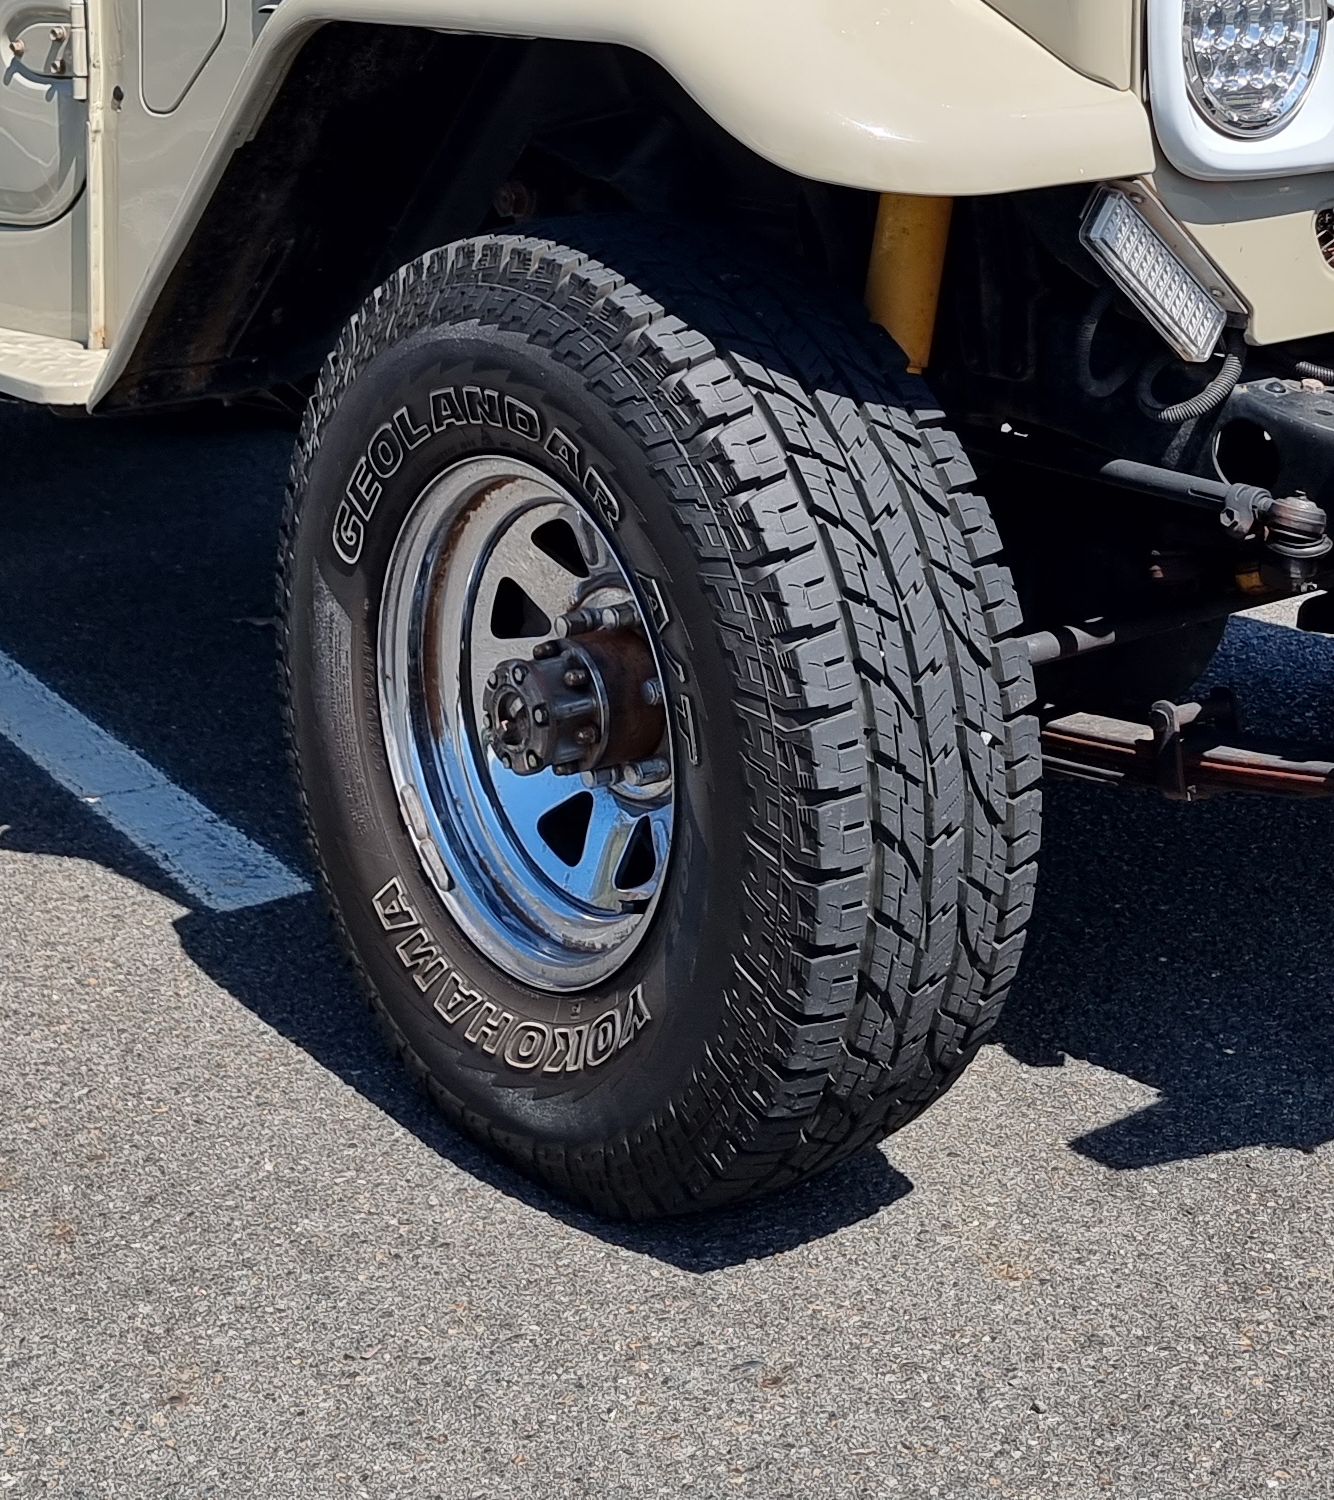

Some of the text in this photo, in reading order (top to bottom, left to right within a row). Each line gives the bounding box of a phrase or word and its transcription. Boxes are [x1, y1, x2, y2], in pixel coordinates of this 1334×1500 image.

[332, 386, 620, 564] GEOLANDAR
[634, 570, 699, 766] A/T
[371, 875, 653, 1073] YOKOHAMA
